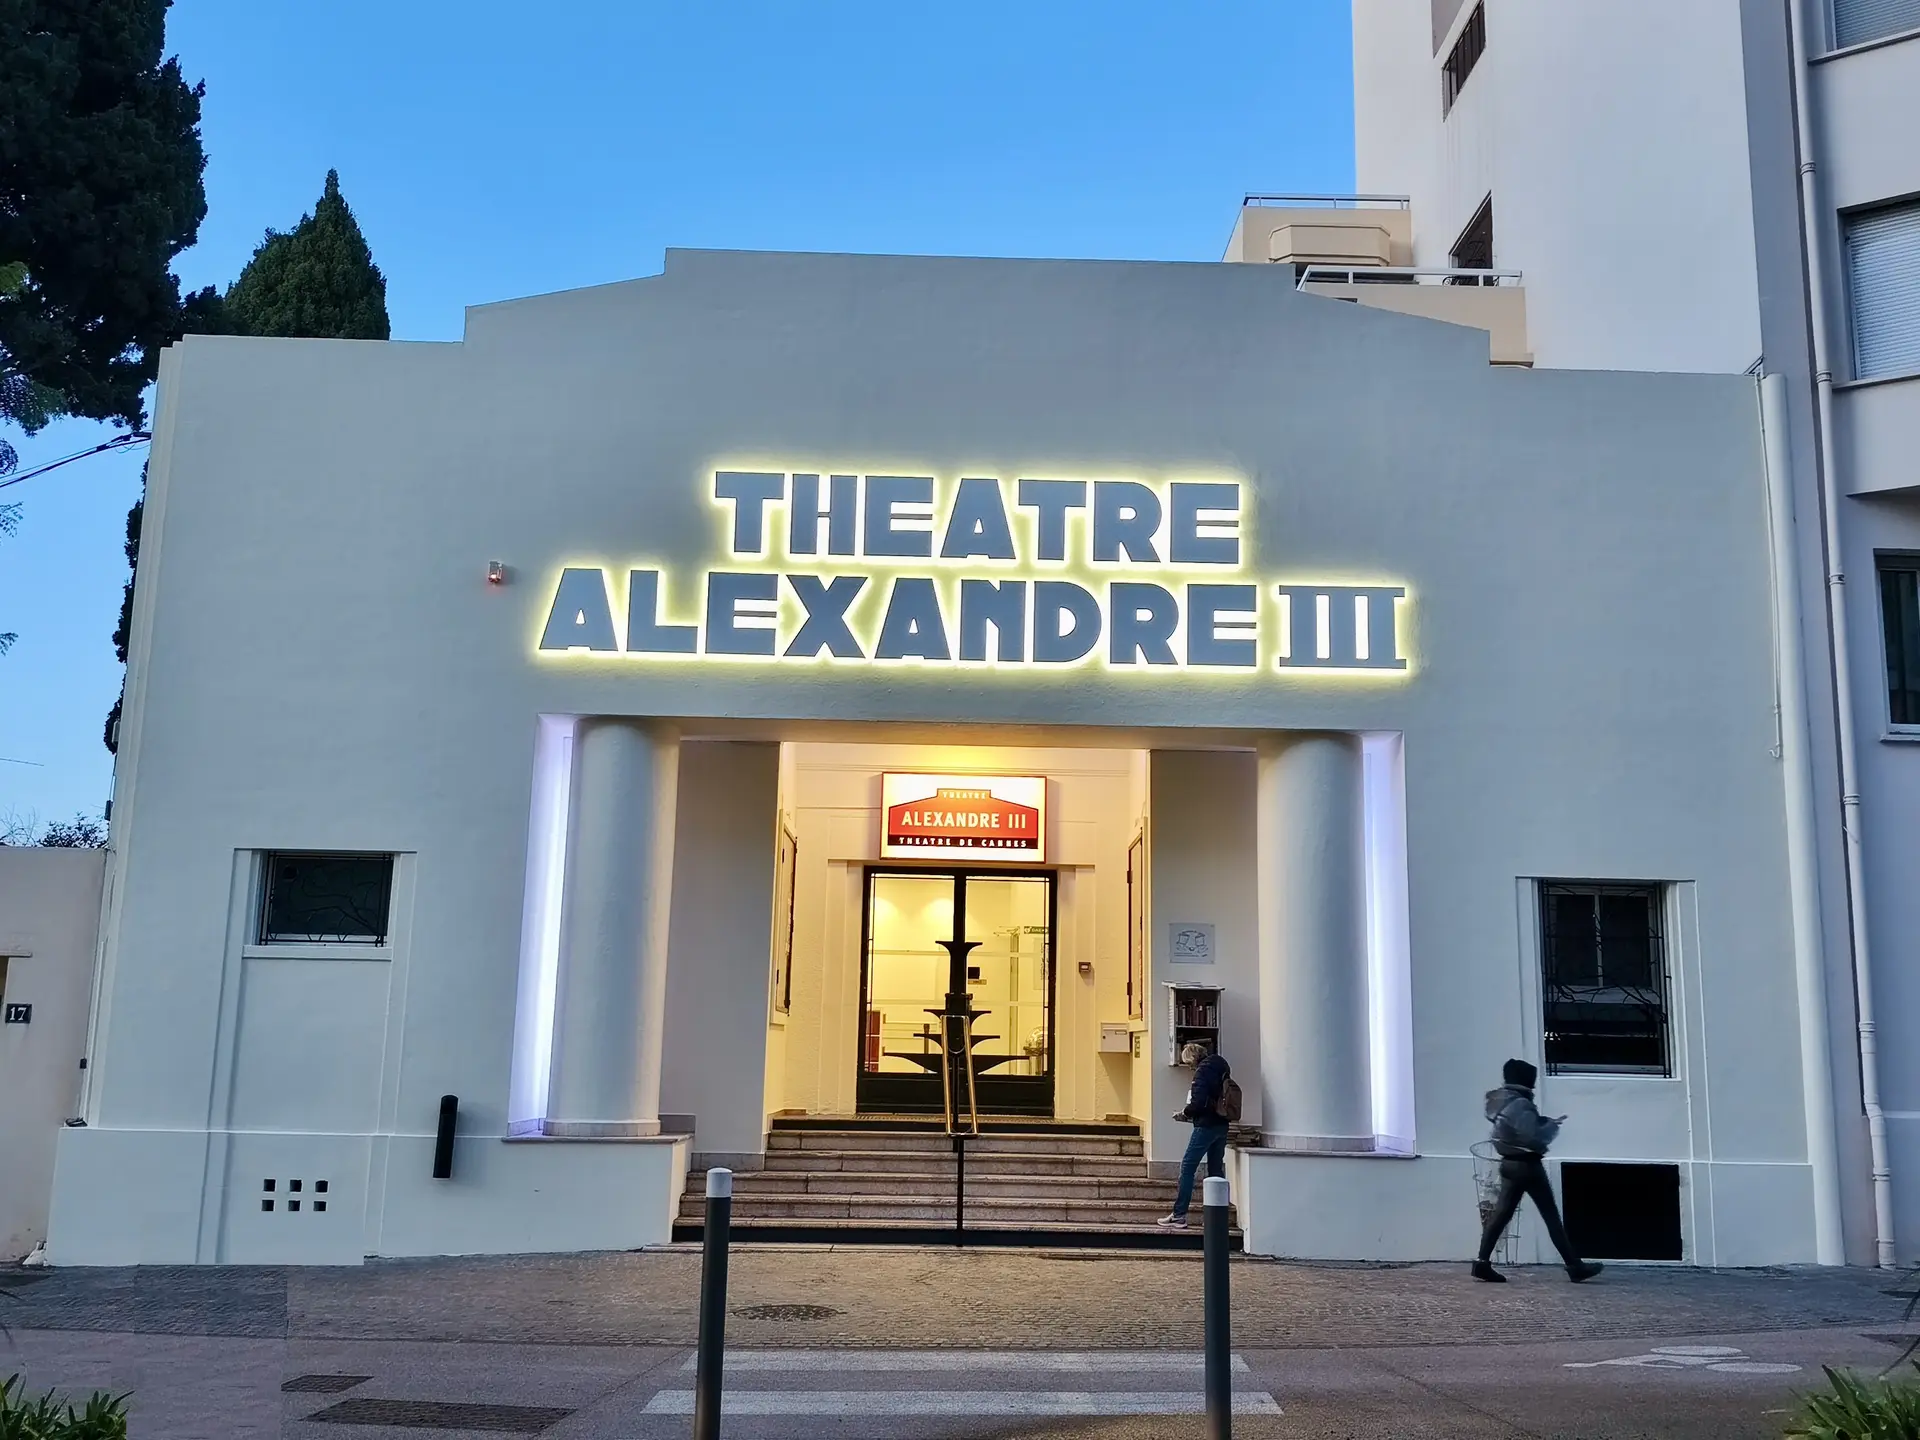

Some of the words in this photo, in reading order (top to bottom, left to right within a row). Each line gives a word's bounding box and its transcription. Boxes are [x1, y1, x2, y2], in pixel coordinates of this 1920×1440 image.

[715, 471, 1240, 564] THEATRE
[538, 567, 1257, 667] ALEXANDRE
[1278, 584, 1407, 670] III
[901, 811, 1001, 828] ALEXANDRE
[1008, 814, 1027, 829] III
[899, 837, 951, 846] THEATRE
[959, 838, 973, 847] DE
[981, 839, 1027, 848] CANNES
[10, 1006, 27, 1021] 17
